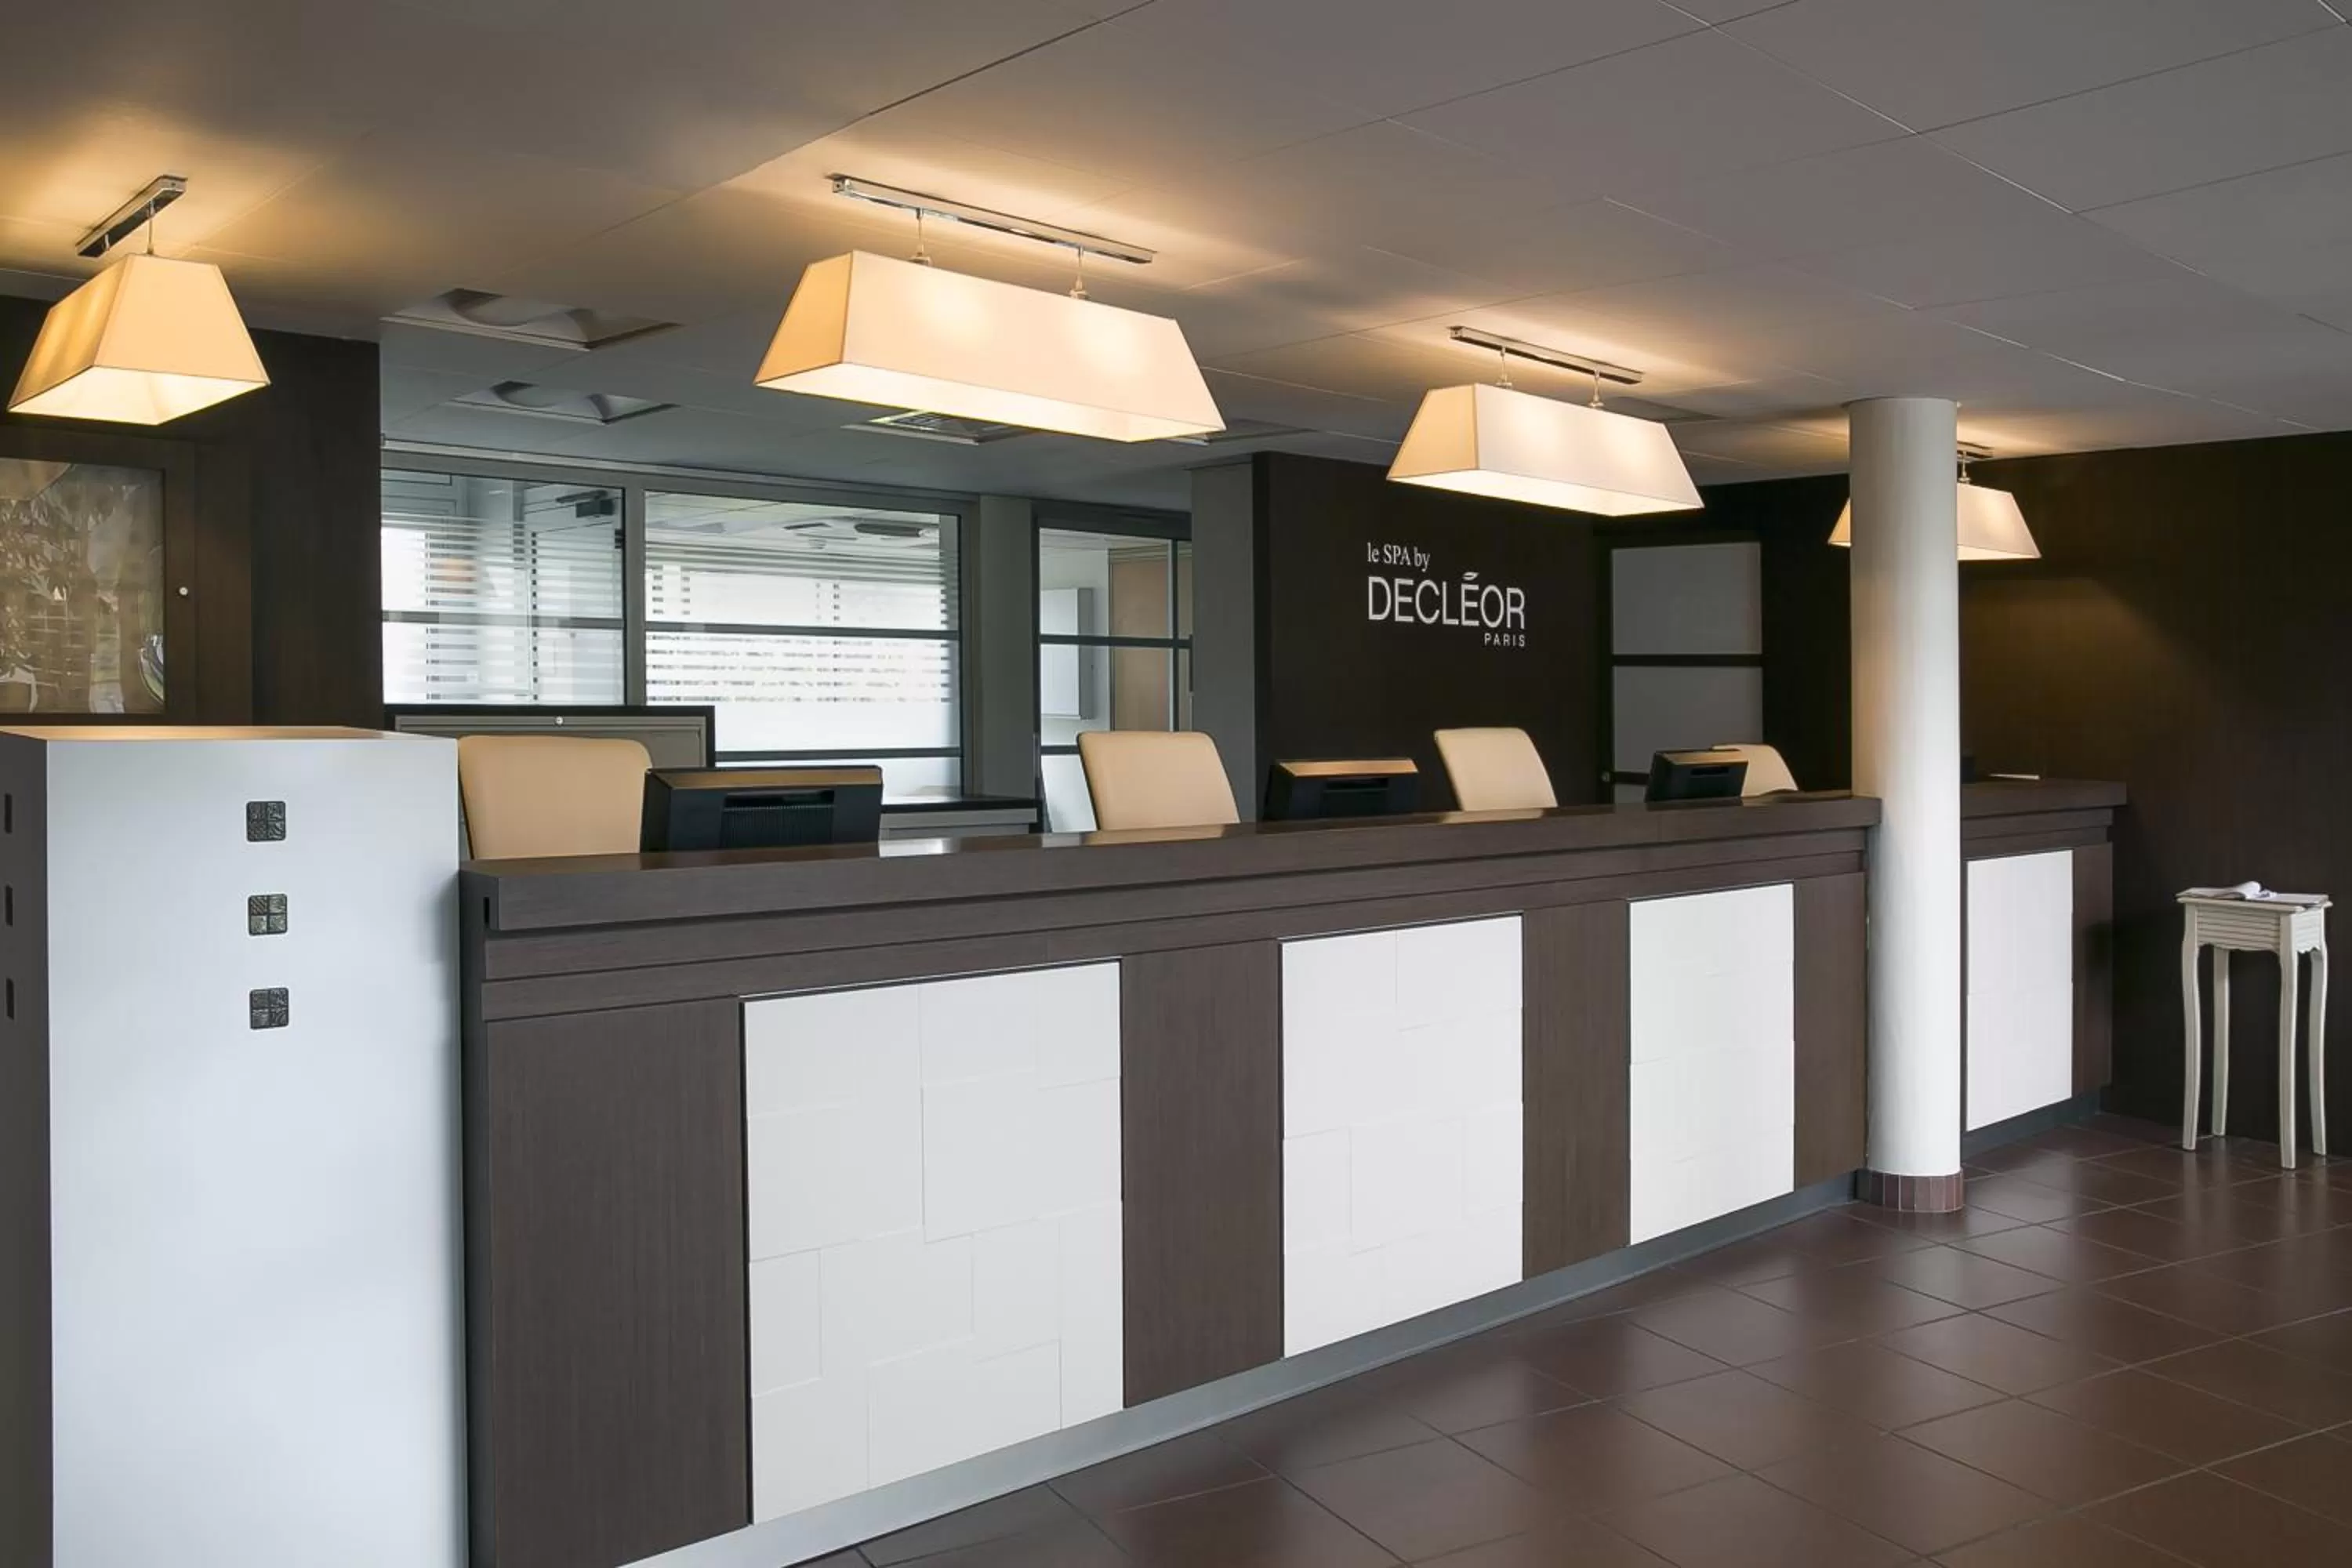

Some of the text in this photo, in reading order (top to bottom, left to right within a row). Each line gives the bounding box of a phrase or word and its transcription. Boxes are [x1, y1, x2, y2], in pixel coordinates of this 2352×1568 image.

[1367, 542, 1430, 572] le SPA by
[1368, 572, 1525, 630] DECLÉOR
[1484, 633, 1525, 647] PARIS
